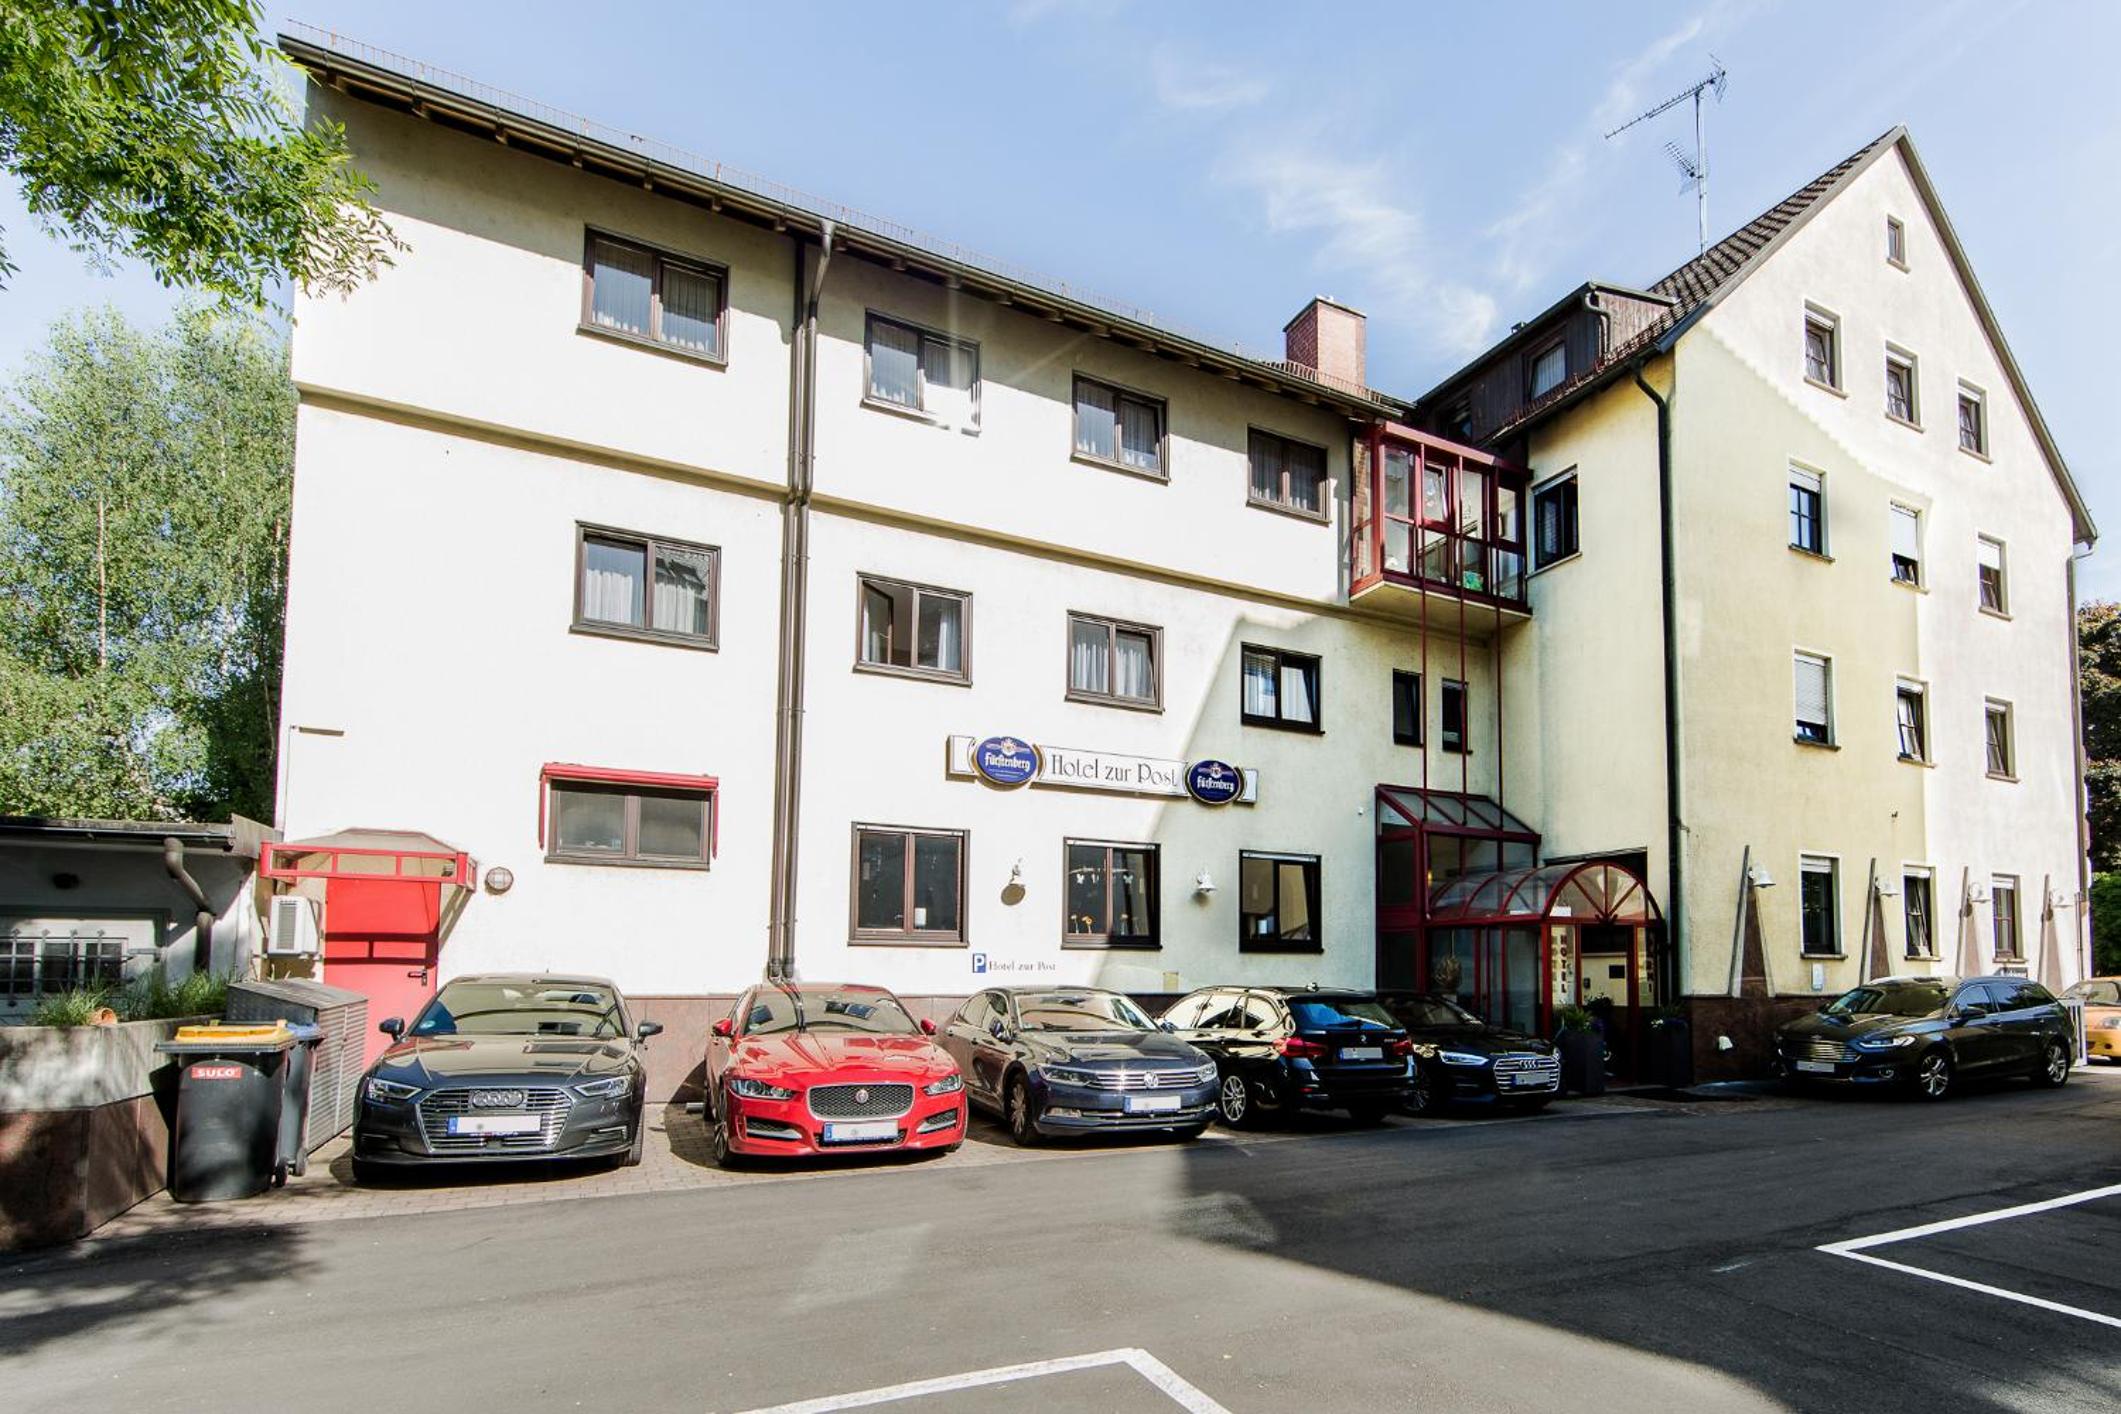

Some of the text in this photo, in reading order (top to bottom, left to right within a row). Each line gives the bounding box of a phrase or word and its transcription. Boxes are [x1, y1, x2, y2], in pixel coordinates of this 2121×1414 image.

[985, 752, 1030, 772] Fürstenberg
[1052, 754, 1177, 787] Hotel zur Post
[1197, 775, 1234, 793] Fürstenberg
[989, 960, 1056, 971] Hotel zur Post
[1560, 934, 1568, 993] HOTEL
